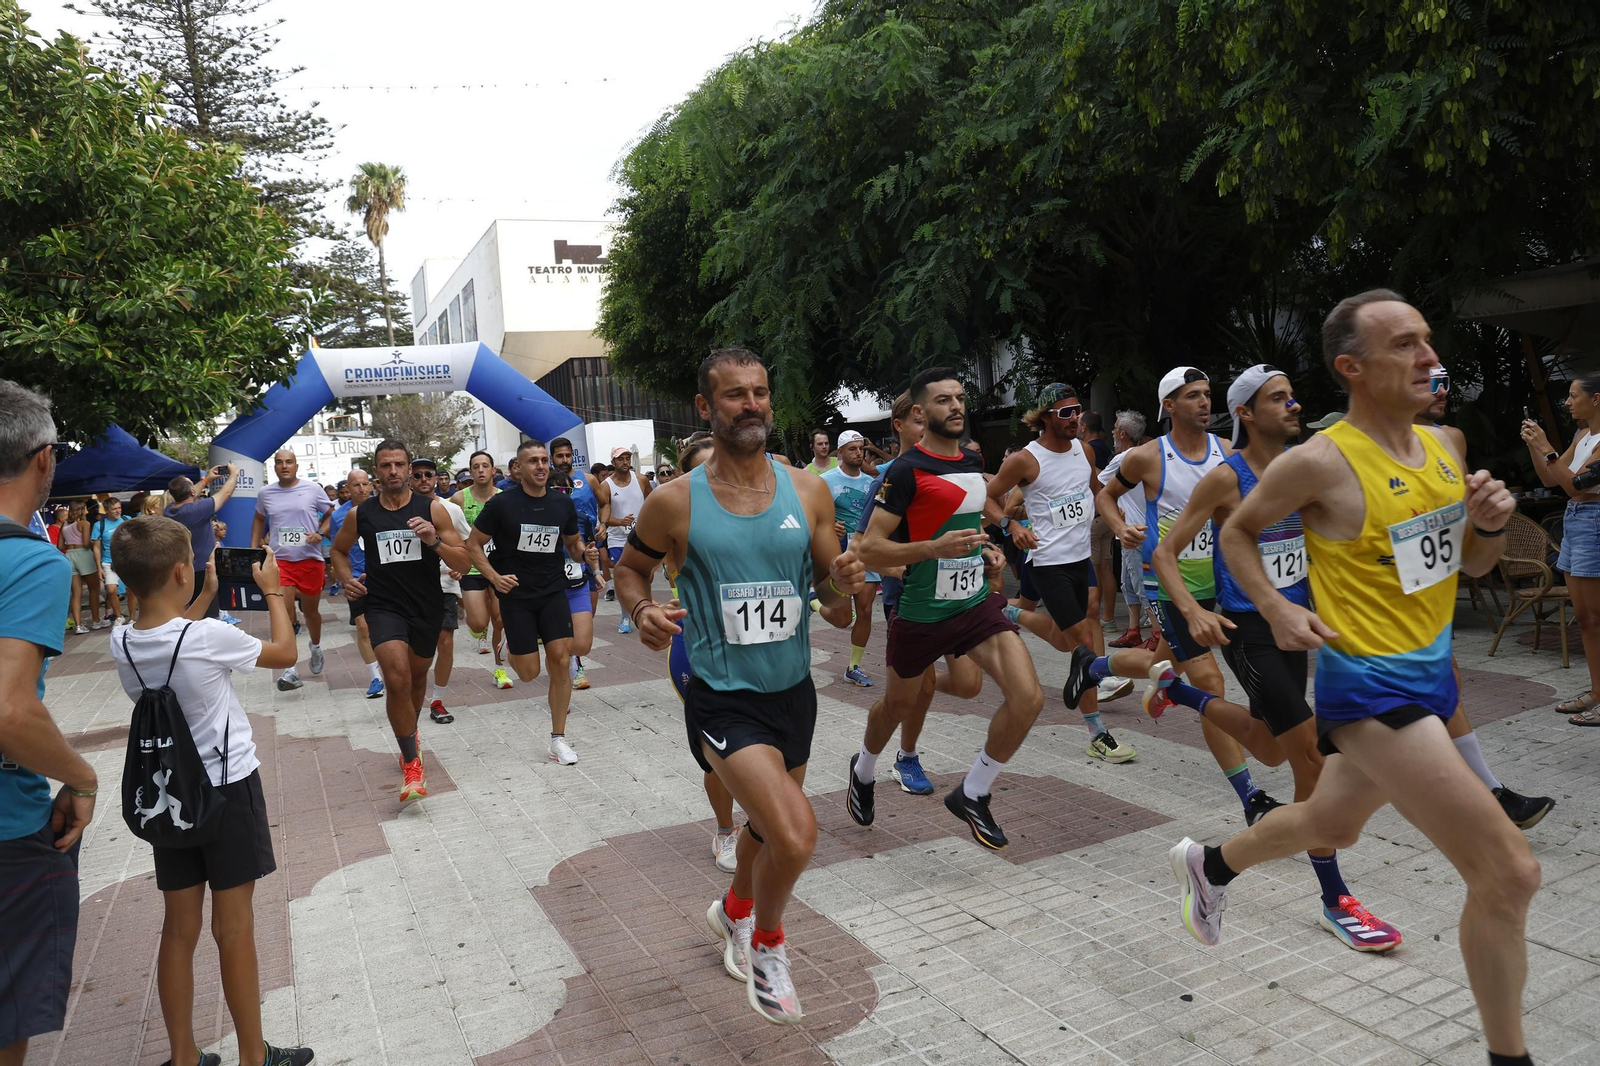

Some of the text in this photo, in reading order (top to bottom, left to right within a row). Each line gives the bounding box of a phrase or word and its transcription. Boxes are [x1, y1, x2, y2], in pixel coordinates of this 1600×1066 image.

[528, 266, 572, 274] TEATRO
[345, 364, 451, 383] CRONOFINISHER
[1059, 502, 1083, 520] 135
[283, 532, 300, 542] 129
[527, 533, 551, 547] 145
[386, 540, 412, 556] 107
[1421, 528, 1452, 569] 95
[1272, 550, 1303, 578] 121
[950, 569, 976, 591] 151
[756, 586, 772, 599] ELA
[773, 586, 795, 596] TARIFA
[736, 599, 787, 631] 114
